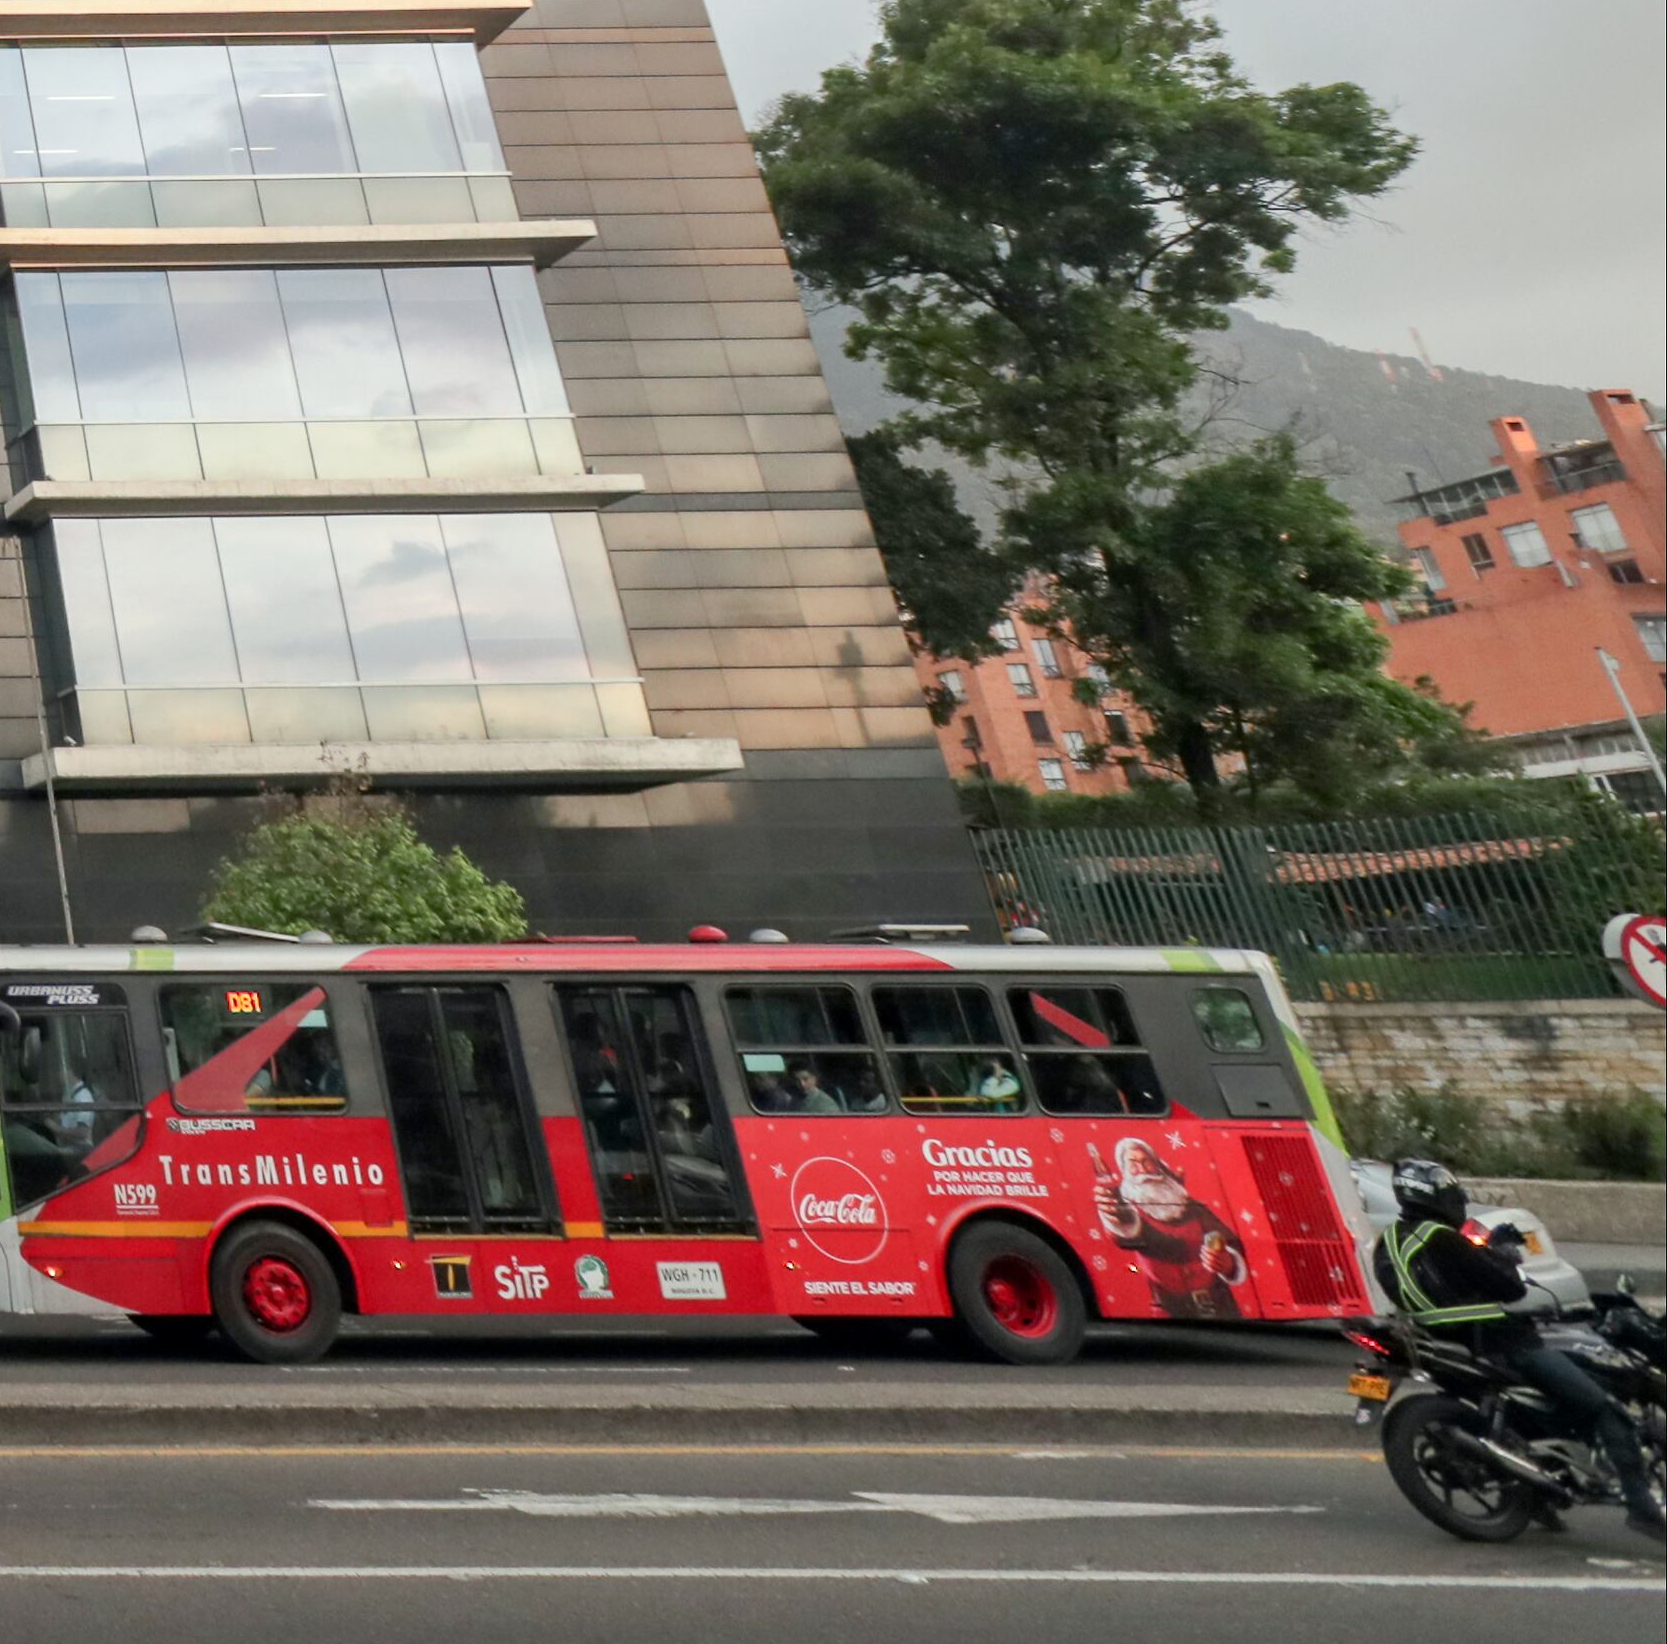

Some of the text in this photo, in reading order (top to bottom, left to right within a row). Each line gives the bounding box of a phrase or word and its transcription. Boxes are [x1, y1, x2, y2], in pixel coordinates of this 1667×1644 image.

[47, 994, 99, 1004] PLUSS
[227, 992, 261, 1012] D81
[922, 1139, 1033, 1167] Gracias
[158, 1154, 383, 1185] TransMilenio
[933, 1170, 1035, 1184] POR HACER QUE
[114, 1184, 157, 1205] N599
[926, 1184, 1050, 1197] LA NAVIDAD BRILLE
[803, 1281, 915, 1295] SIENTE EL SABOR
